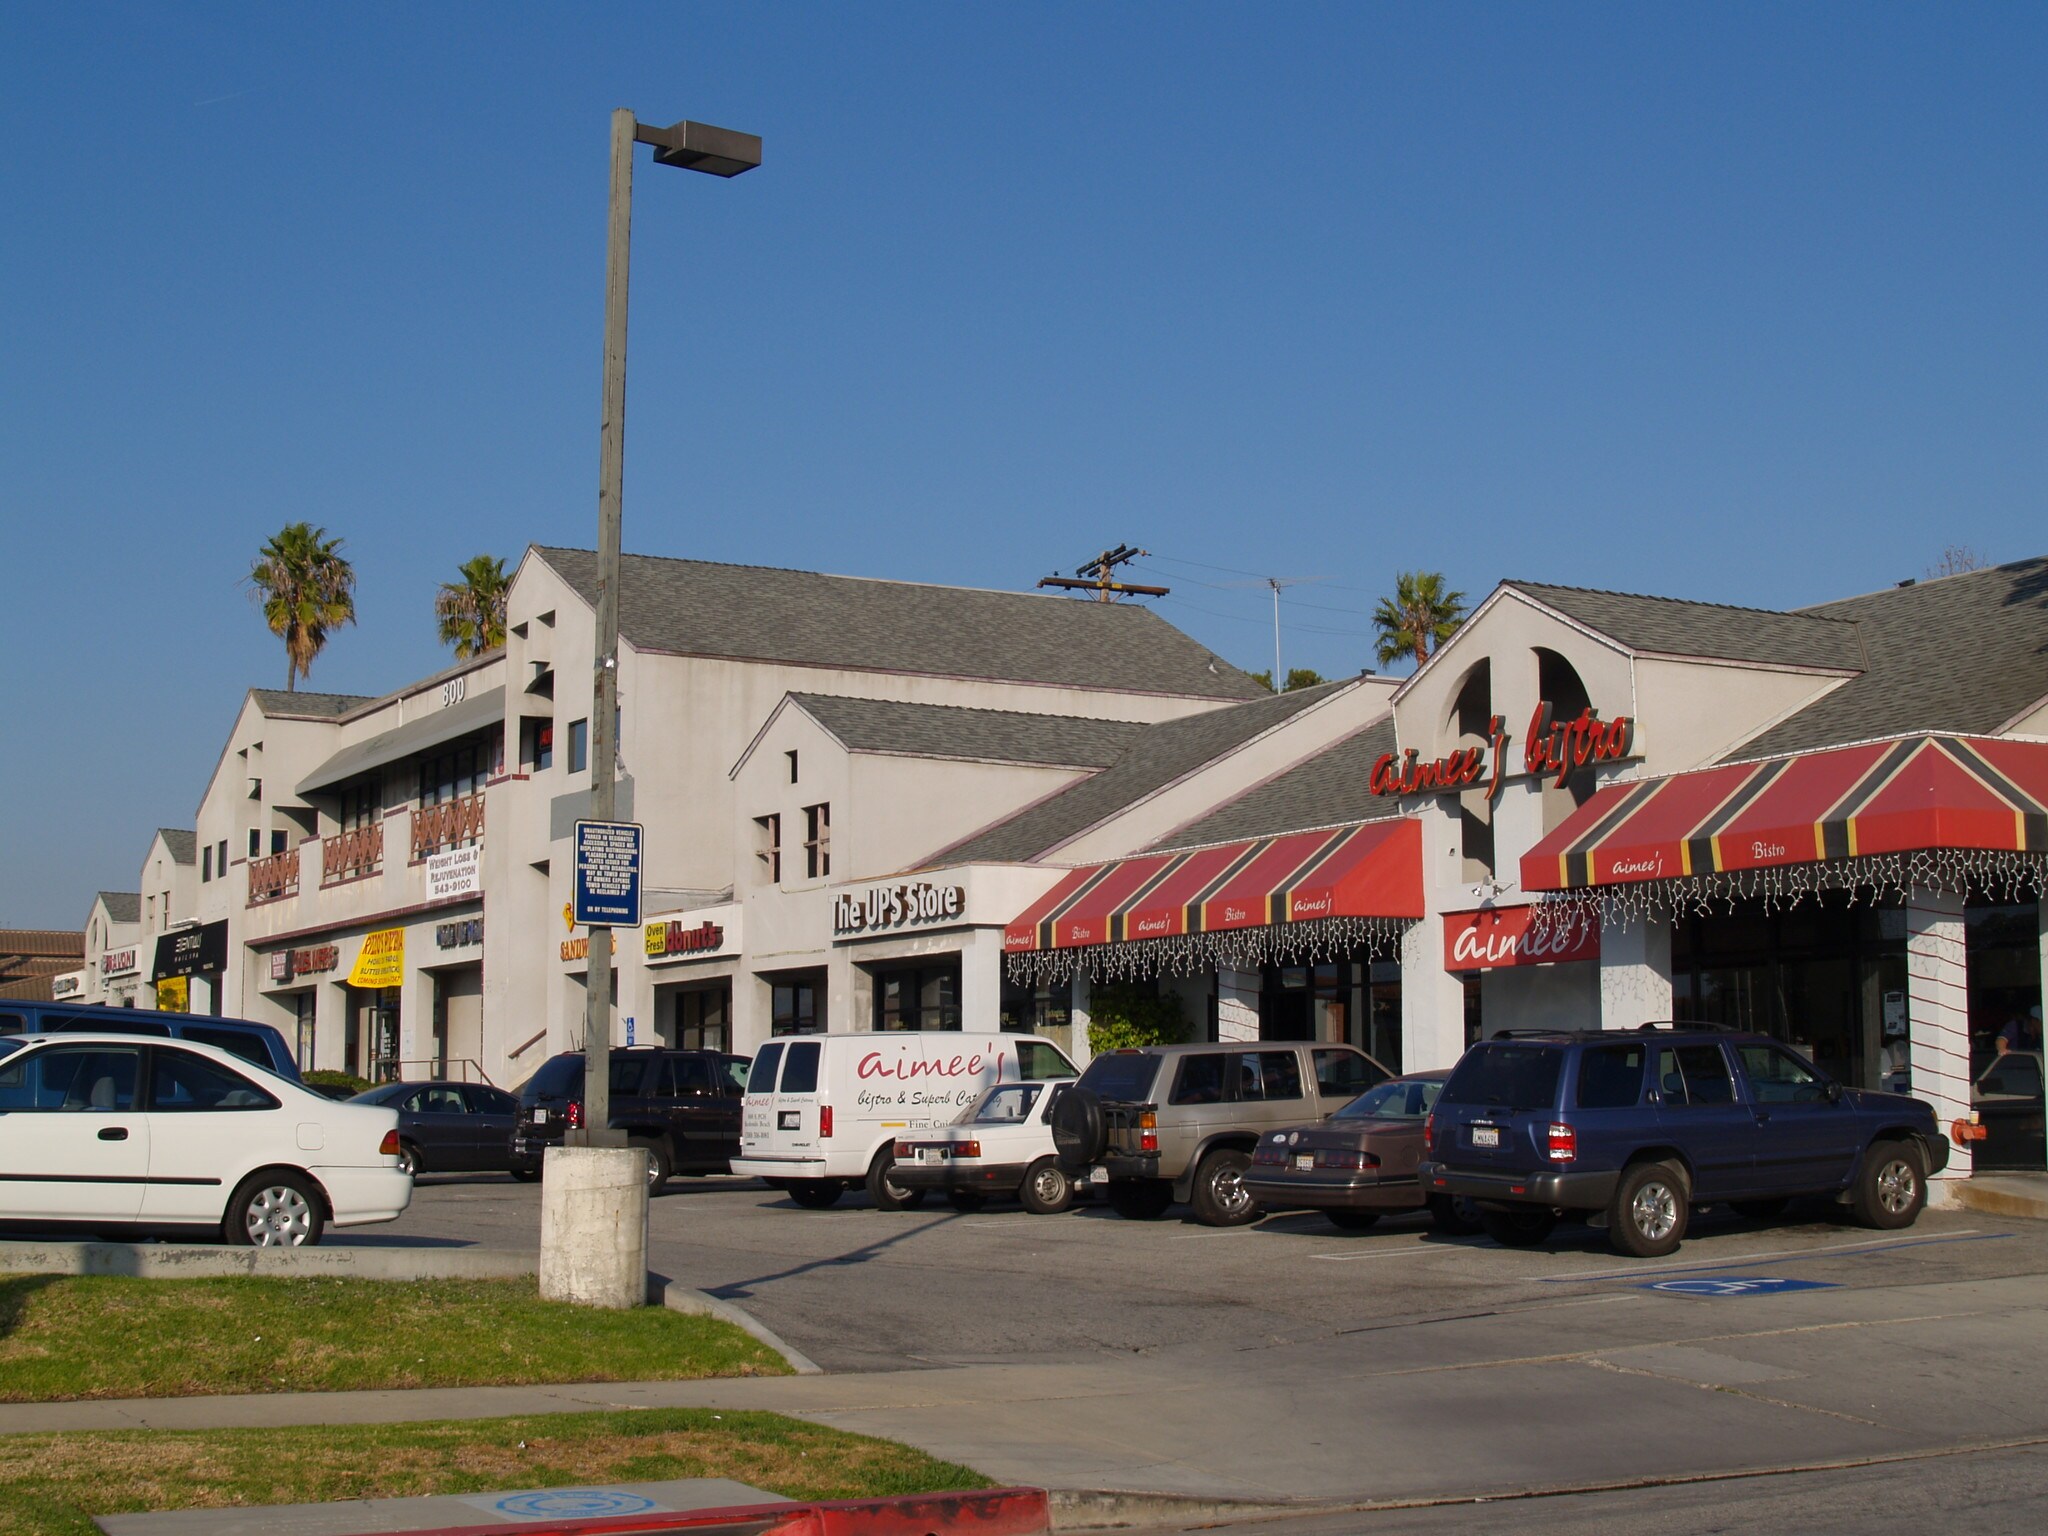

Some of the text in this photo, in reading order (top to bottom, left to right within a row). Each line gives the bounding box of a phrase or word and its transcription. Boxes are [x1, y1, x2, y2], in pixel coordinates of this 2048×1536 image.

[443, 676, 465, 706] 800
[1369, 700, 1633, 801] aimee's bistro
[583, 839, 608, 847] ACCESSIBLE
[584, 827, 635, 837] UNAUTHORIZED VEHICLES
[605, 846, 638, 855] DISTINGUISHING
[1612, 841, 1785, 876] aimee's Bistro
[587, 905, 594, 913] OR
[601, 906, 629, 914] TELEPHONING
[828, 881, 962, 930] The UPS Store
[646, 925, 664, 937] Oven
[1005, 891, 1332, 948] aimee's Bistro aimee's Bistro aimee's
[645, 936, 664, 952] Fresh
[666, 920, 722, 952] donuts
[1453, 908, 1588, 962] aimee's
[857, 1041, 1005, 1084] aimee's
[857, 1089, 892, 1112] bistro
[897, 1090, 906, 1105] &
[911, 1090, 951, 1107] Superb
[909, 1119, 929, 1129] Fine
